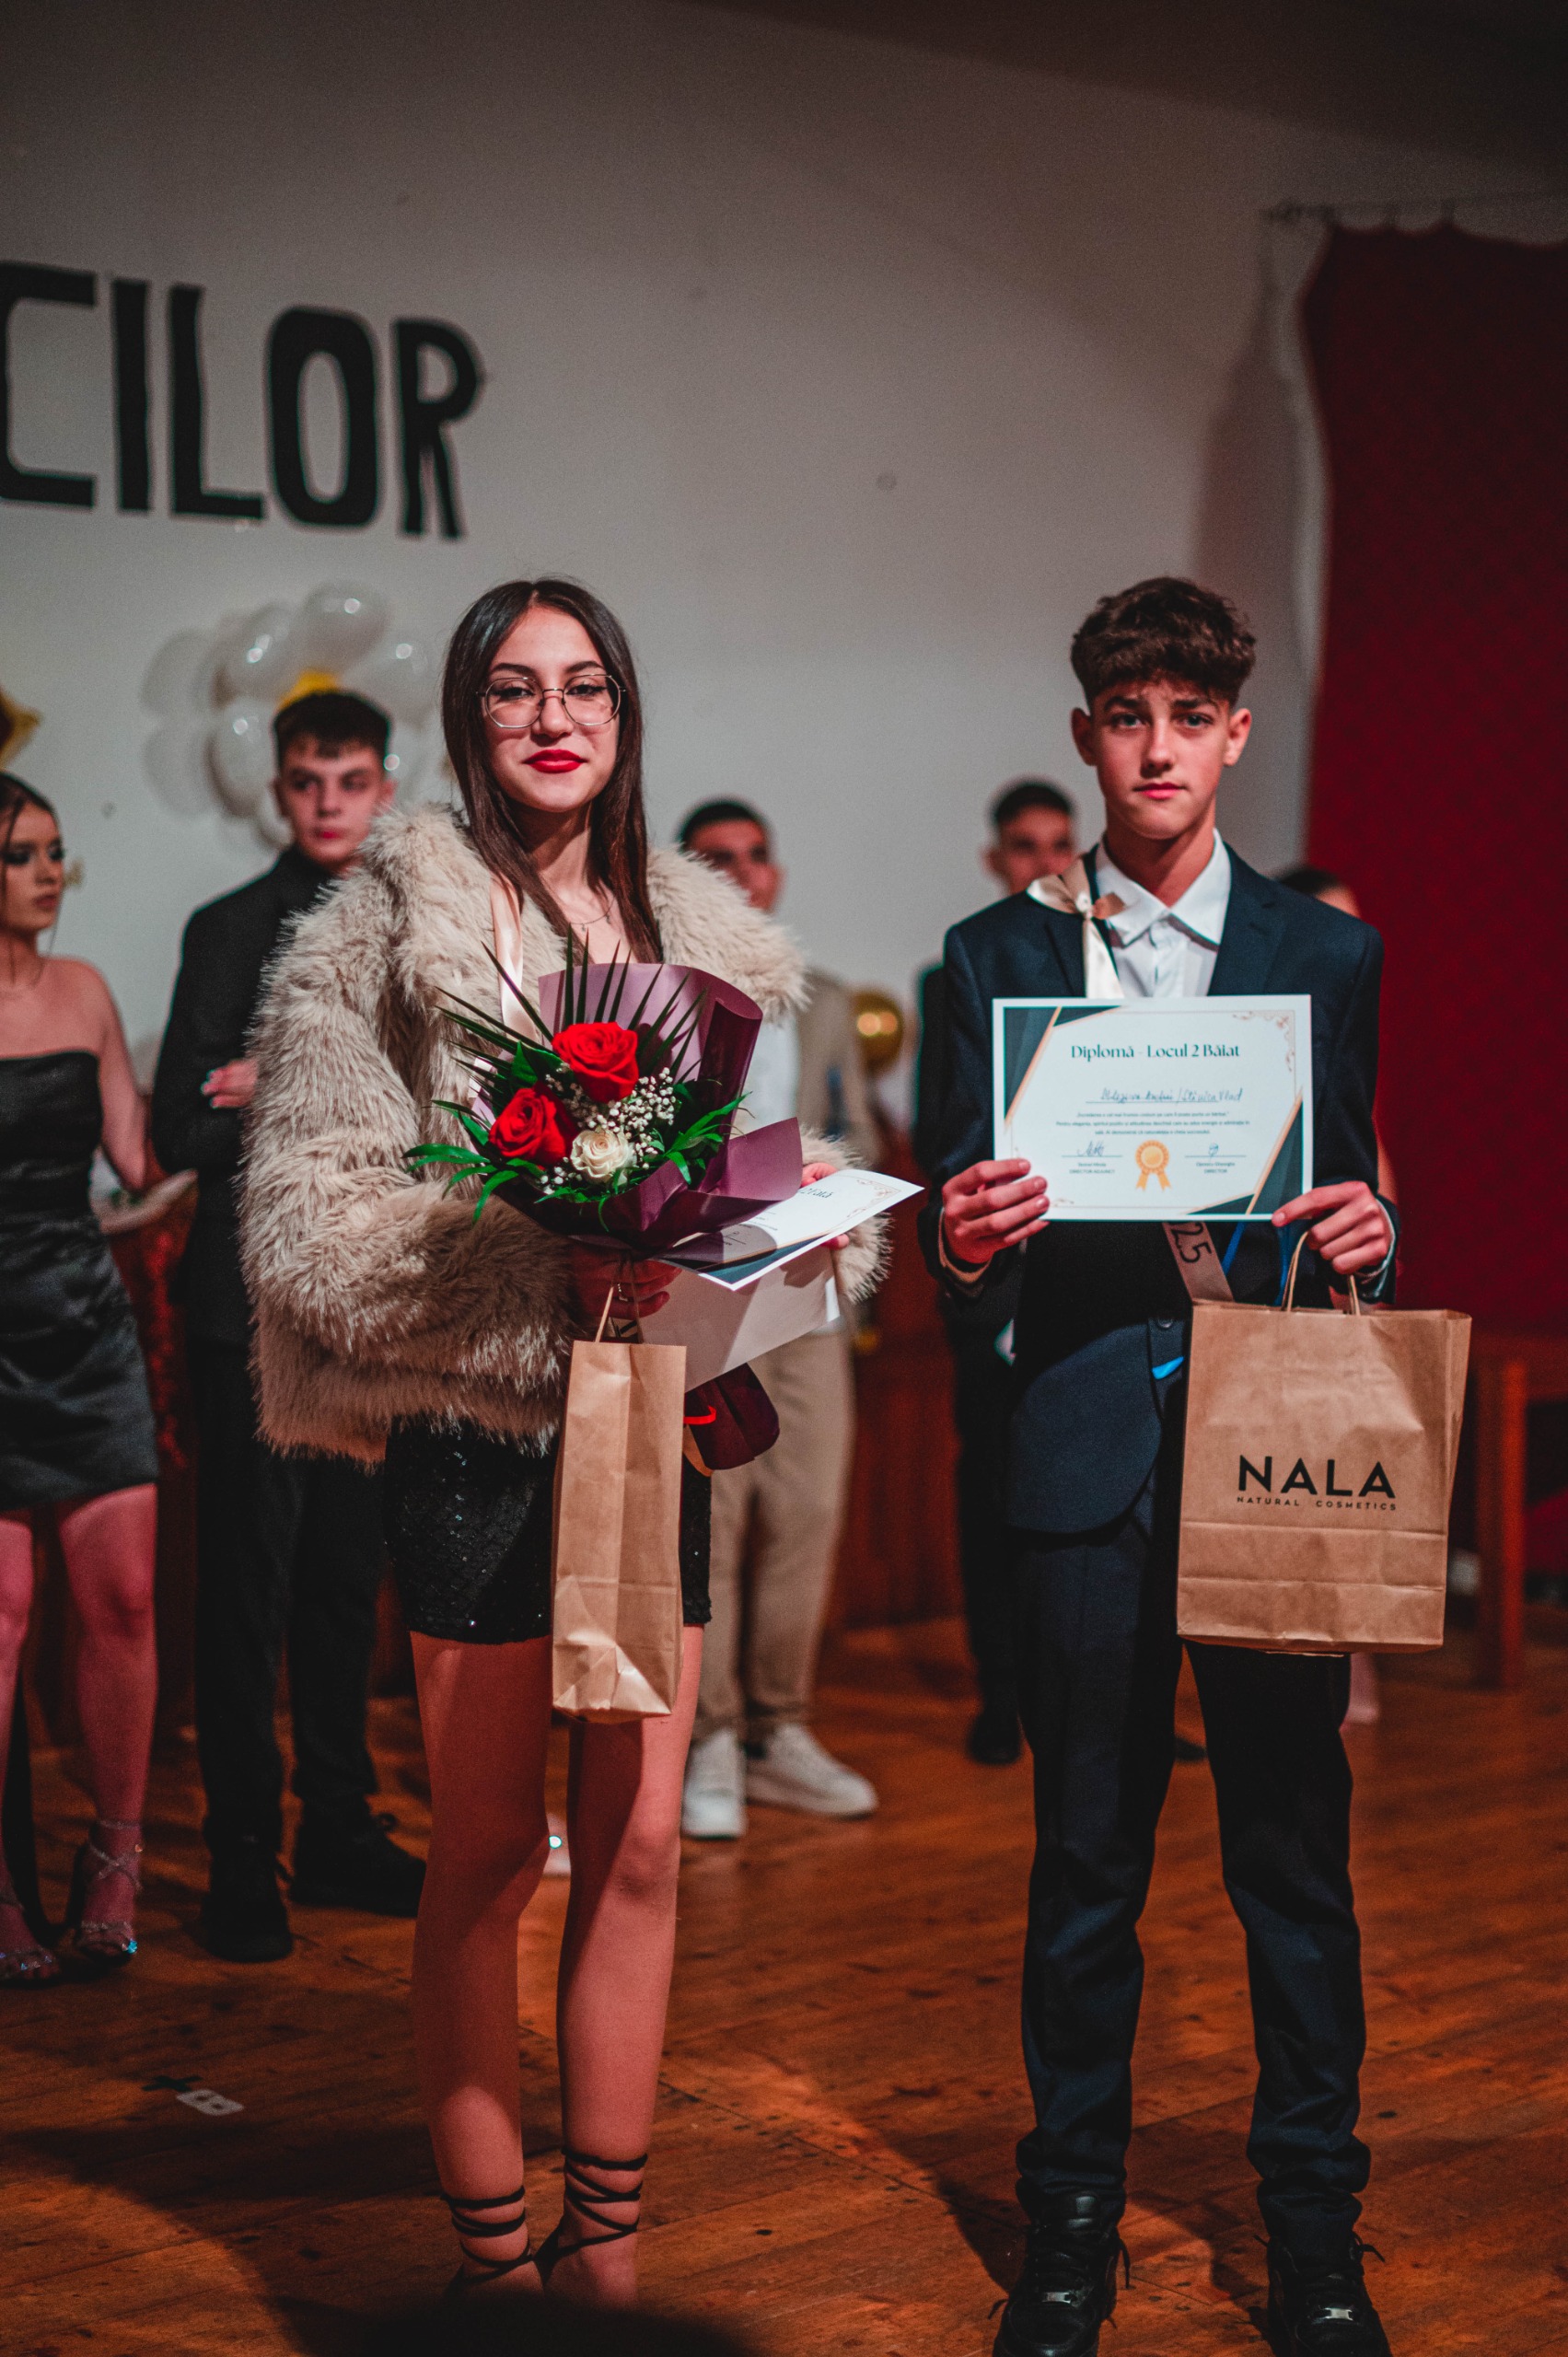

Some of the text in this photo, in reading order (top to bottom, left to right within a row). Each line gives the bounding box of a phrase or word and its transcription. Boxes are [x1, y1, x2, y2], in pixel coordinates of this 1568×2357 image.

[0, 261, 483, 540] CILOR
[1071, 1044, 1134, 1062] Diplomă
[1147, 1043, 1188, 1058] Locul
[1191, 1044, 1200, 1057] 2
[1203, 1044, 1240, 1057] Băiat
[1167, 1222, 1213, 1263] 25
[1238, 1455, 1396, 1499] NALA
[1237, 1496, 1396, 1510] NATURAL COSMETICS
